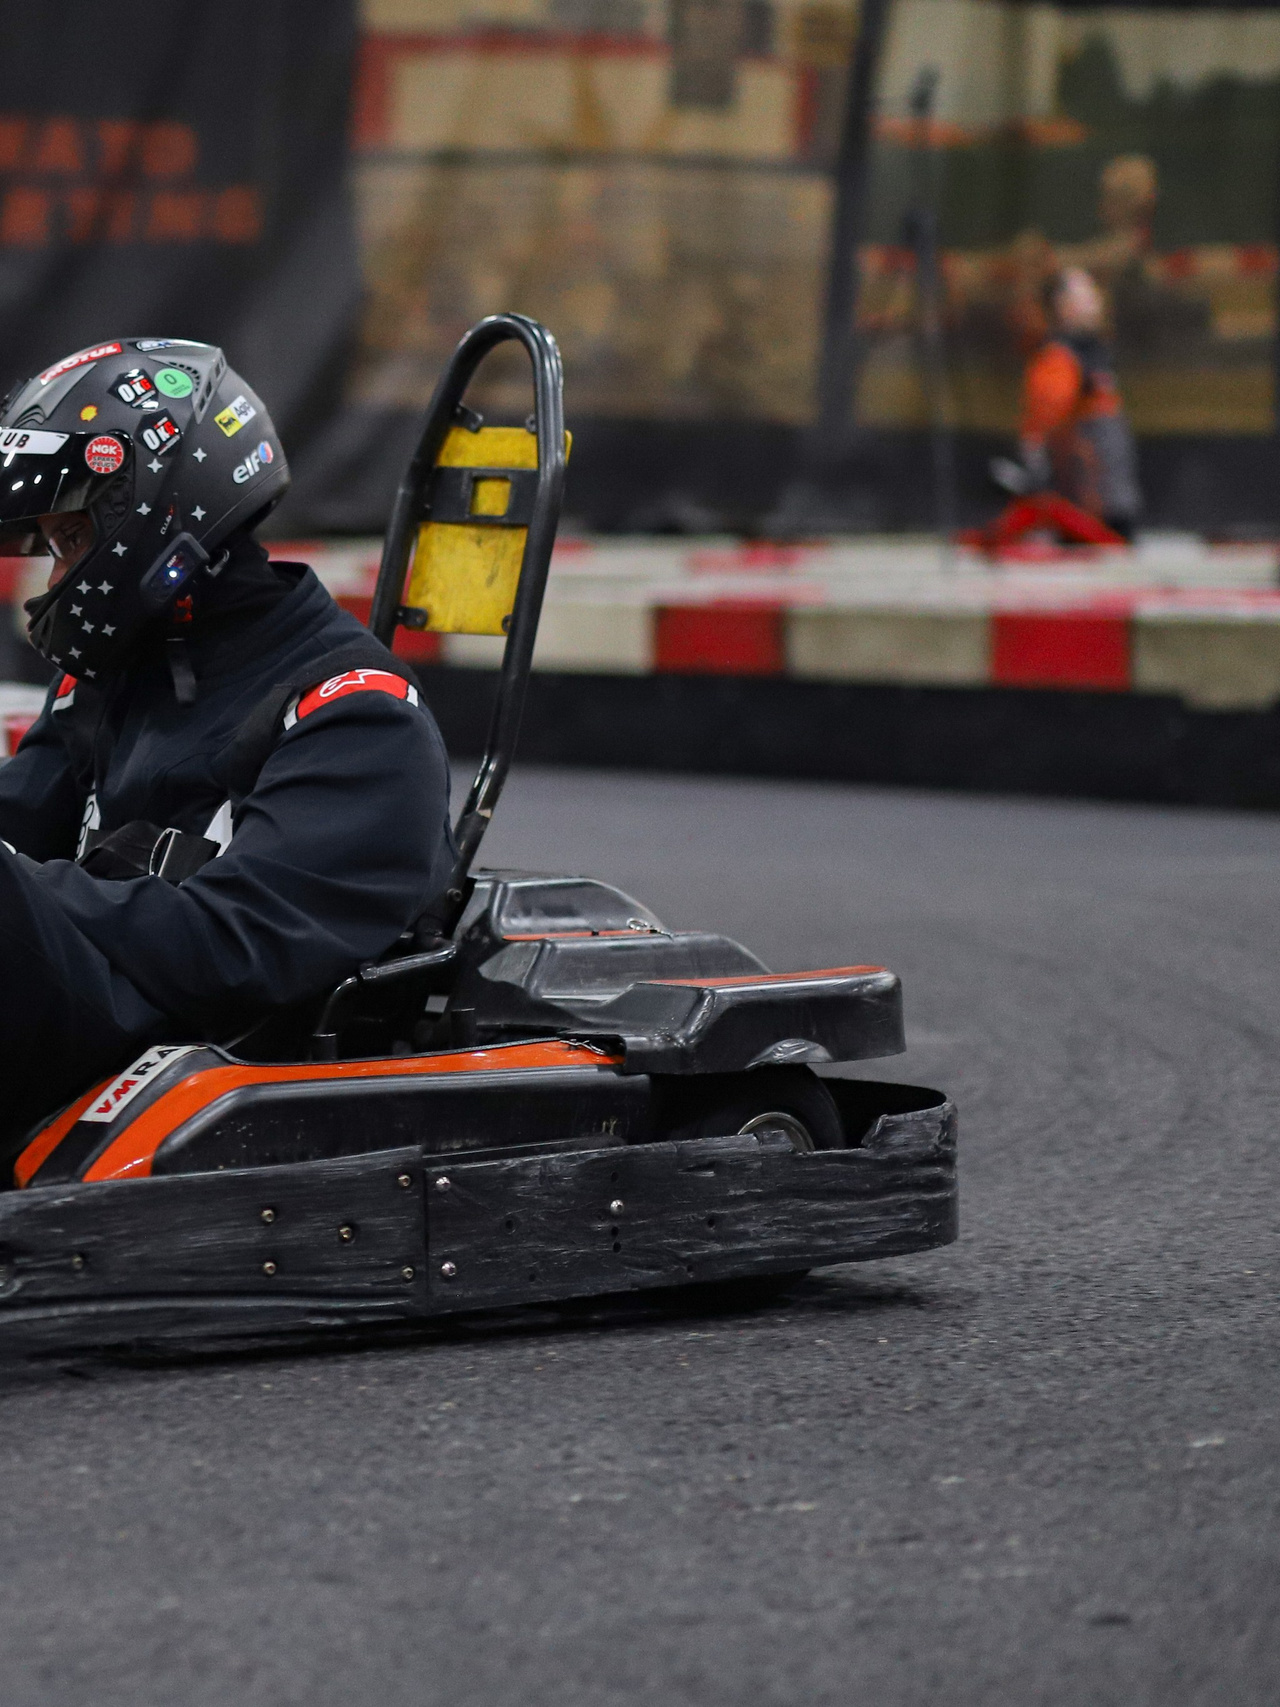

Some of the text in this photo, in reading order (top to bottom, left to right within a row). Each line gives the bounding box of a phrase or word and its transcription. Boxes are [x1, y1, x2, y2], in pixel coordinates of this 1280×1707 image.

[42, 344, 118, 382] MOTUL
[91, 444, 118, 455] NGK
[232, 449, 261, 484] elf
